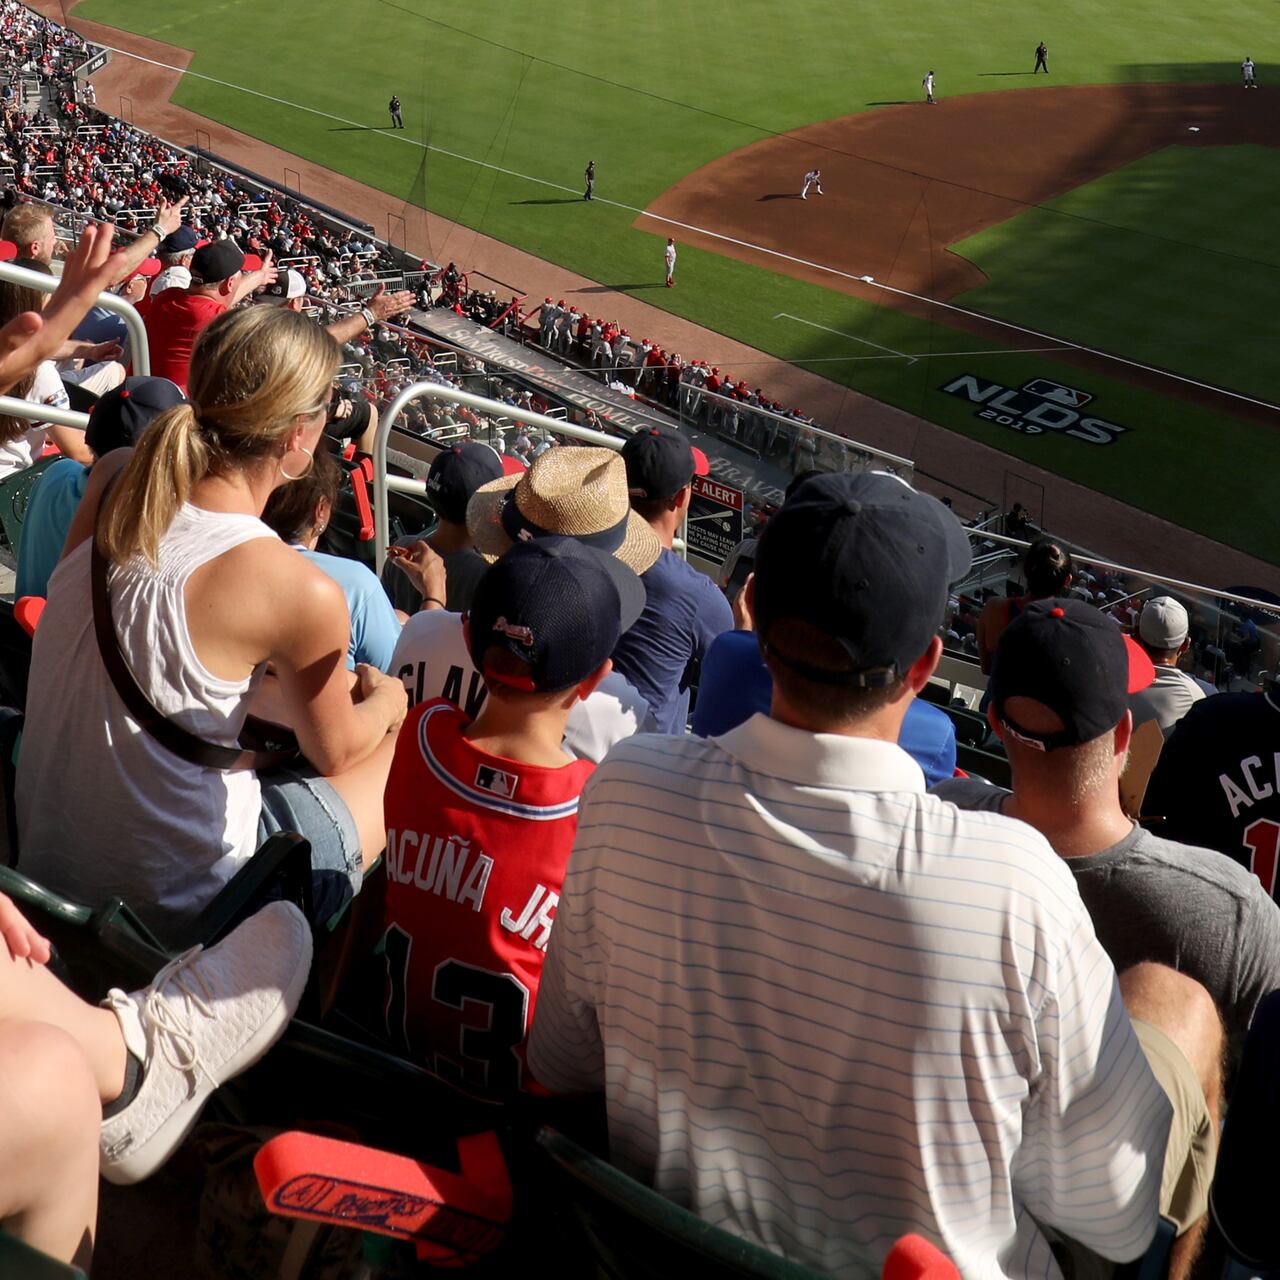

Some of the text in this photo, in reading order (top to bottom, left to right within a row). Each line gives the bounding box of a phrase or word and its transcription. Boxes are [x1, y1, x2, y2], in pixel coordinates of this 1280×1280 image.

[943, 375, 1127, 444] NLDS
[978, 409, 1043, 434] 2019
[702, 482, 737, 505] ALERT
[386, 834, 495, 912] ACUÑA
[382, 922, 530, 1088] 13
